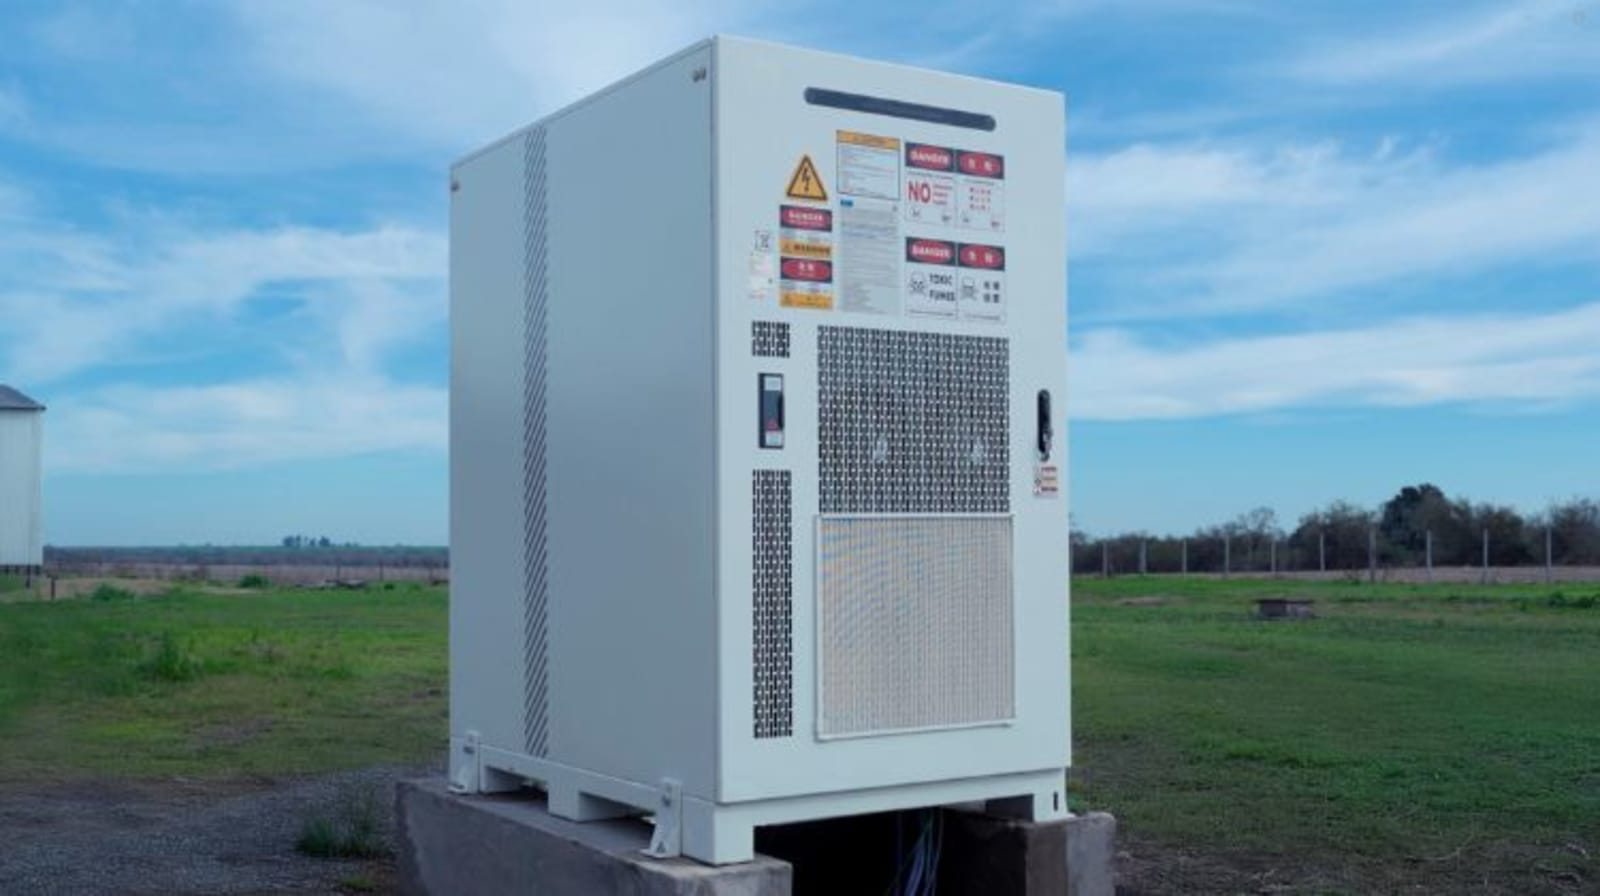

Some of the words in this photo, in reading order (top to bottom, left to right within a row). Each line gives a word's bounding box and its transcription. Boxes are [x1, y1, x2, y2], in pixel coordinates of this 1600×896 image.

[910, 148, 950, 165] DANGER
[908, 181, 931, 204] NO
[912, 244, 952, 259] DANGER
